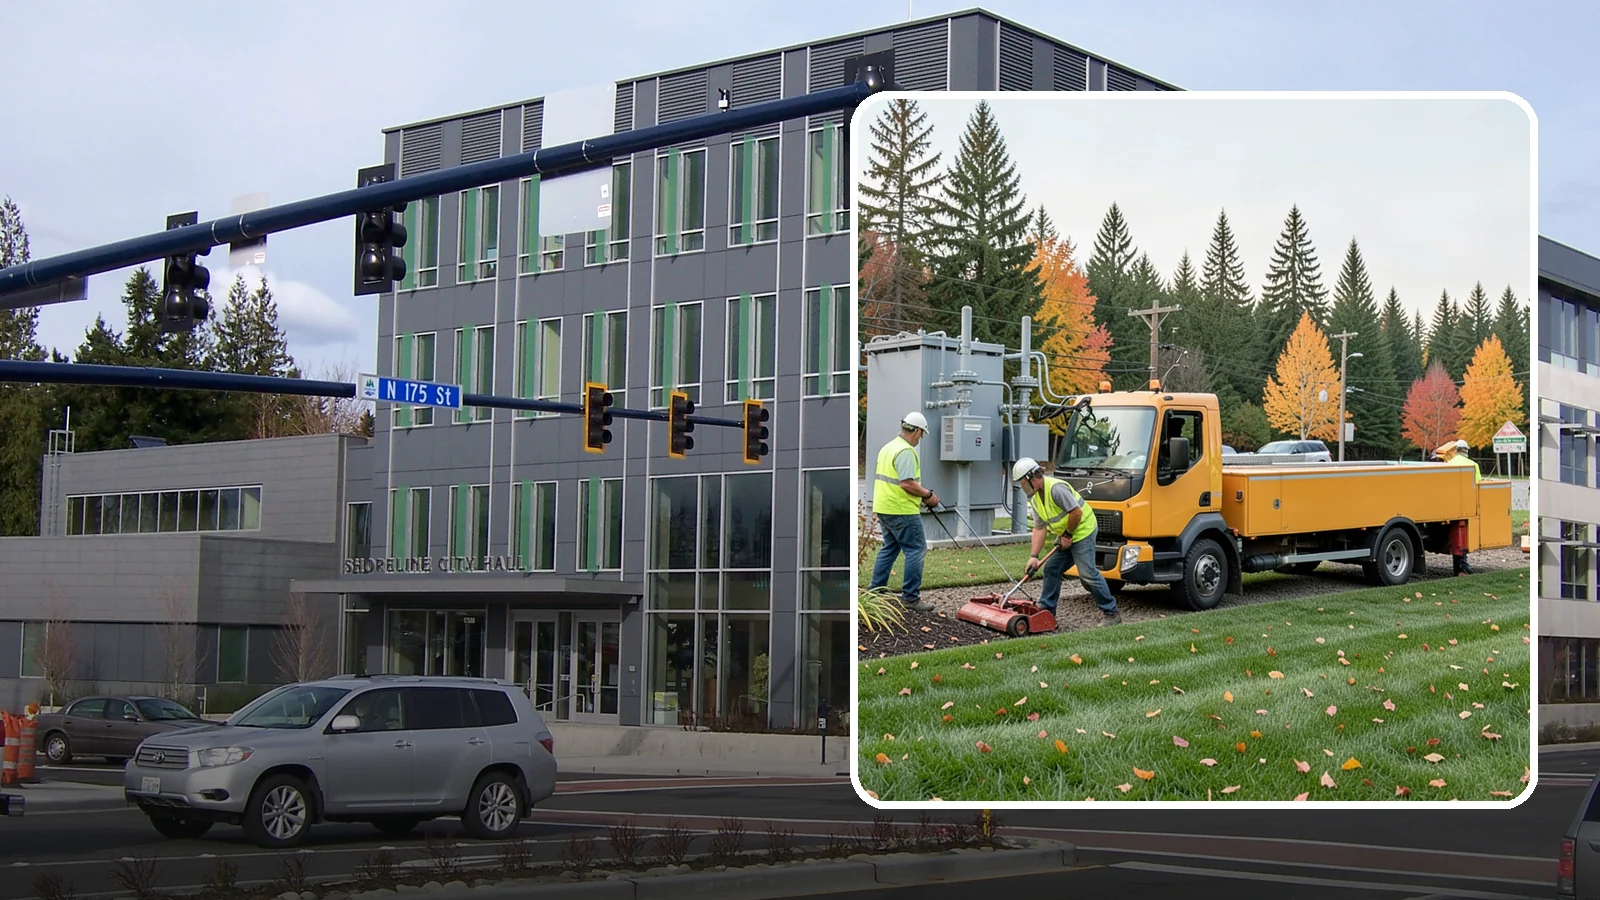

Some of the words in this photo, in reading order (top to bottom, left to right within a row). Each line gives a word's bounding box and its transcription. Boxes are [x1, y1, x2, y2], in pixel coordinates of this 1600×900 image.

[387, 380, 396, 400] N
[405, 382, 428, 403] 175
[436, 386, 452, 406] St
[344, 557, 432, 575] SHORELINE
[438, 556, 476, 572] CITY
[483, 555, 526, 572] HALL
